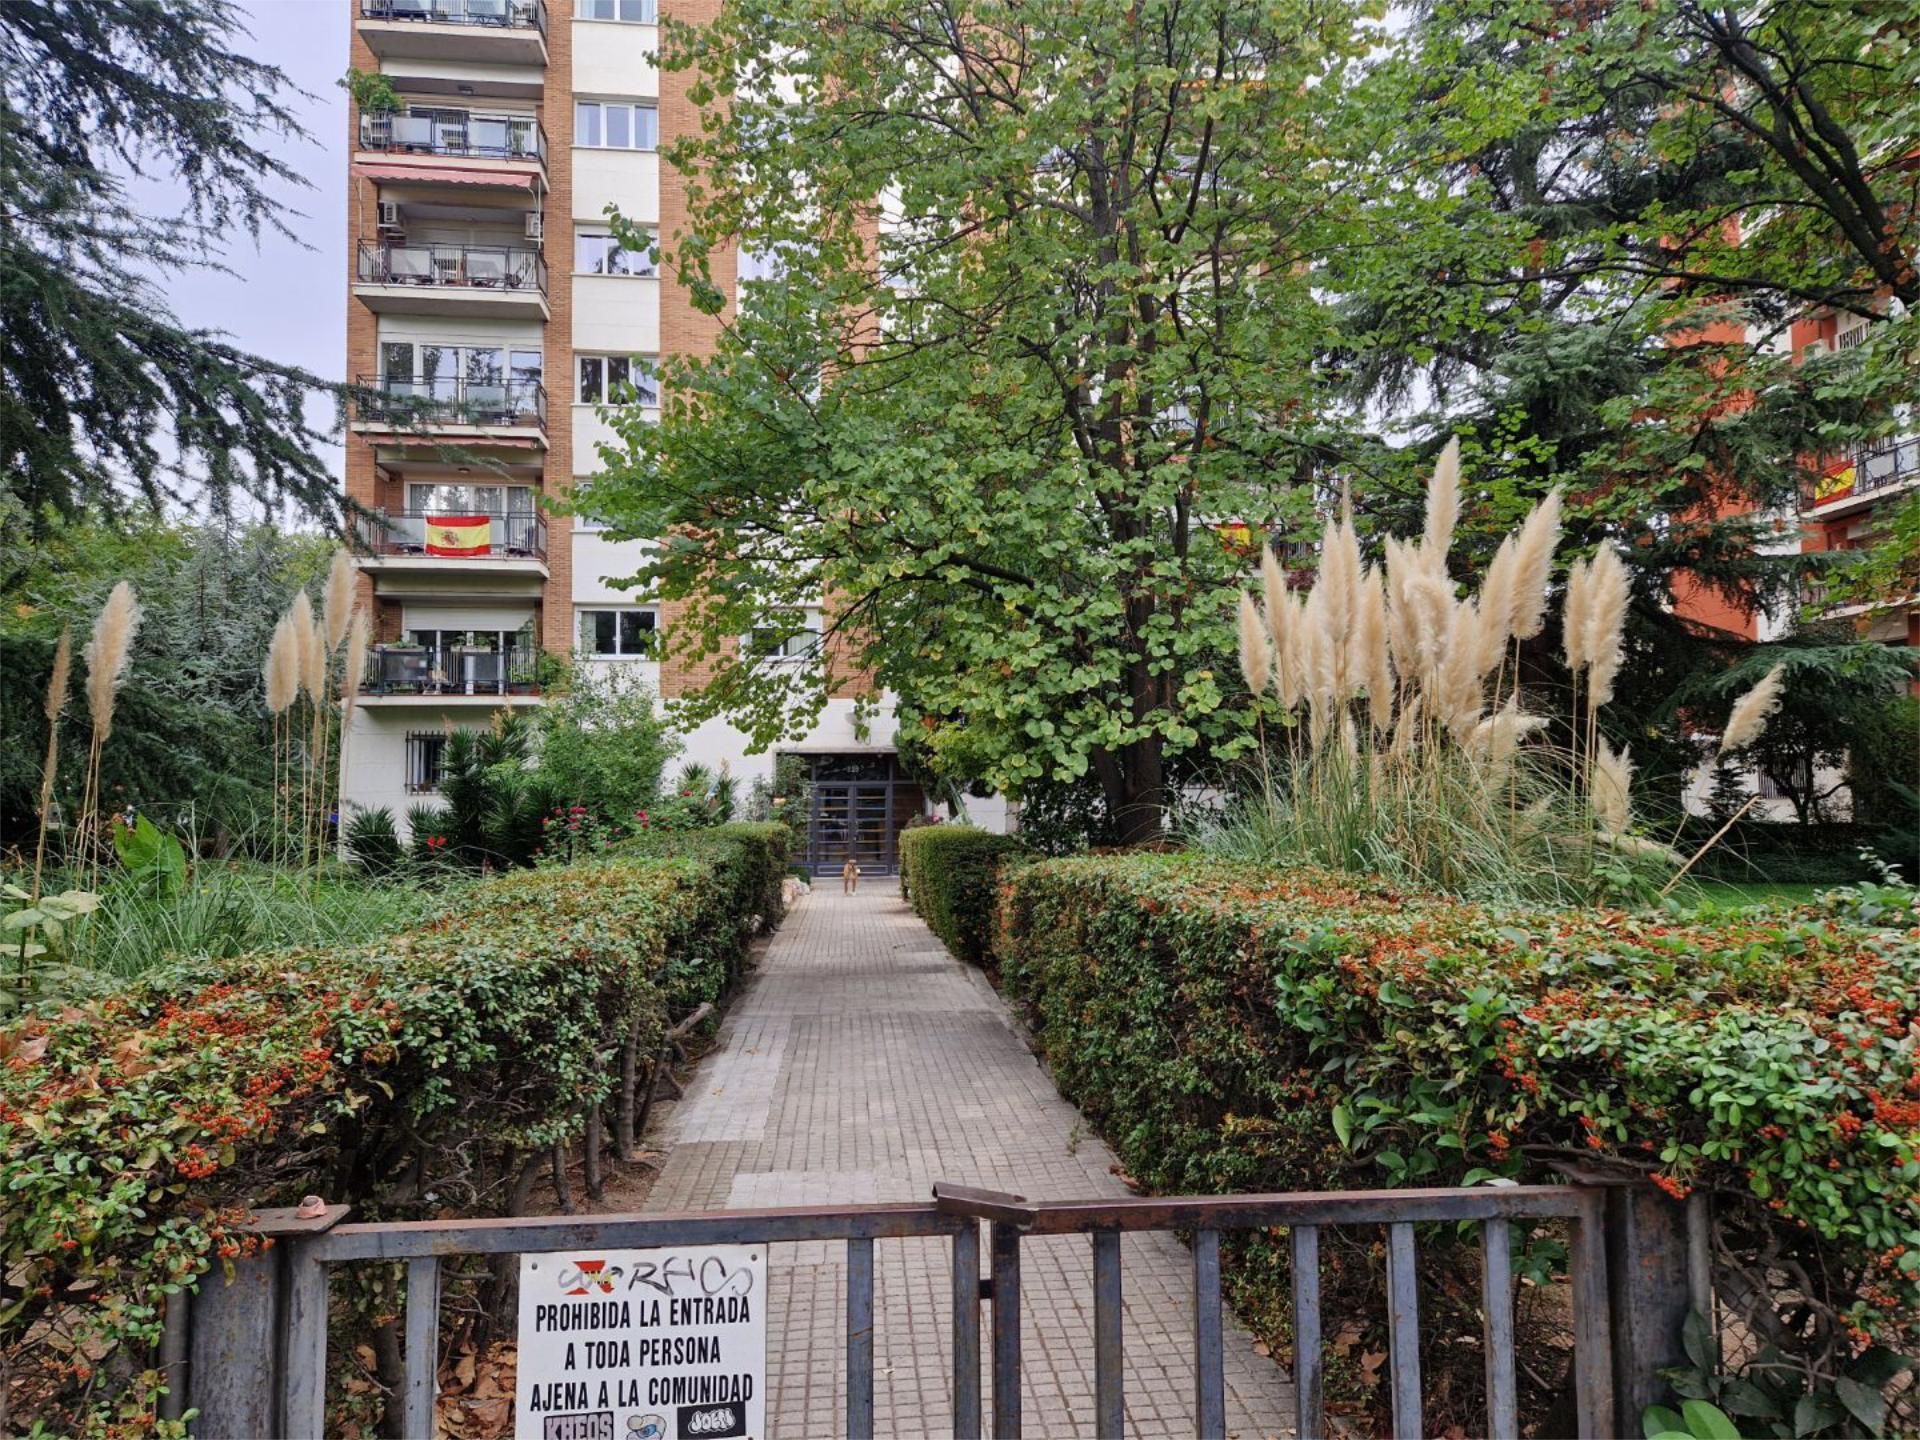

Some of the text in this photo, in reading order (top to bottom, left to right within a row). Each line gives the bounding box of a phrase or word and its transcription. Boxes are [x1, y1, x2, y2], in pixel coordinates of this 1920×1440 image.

[536, 1296, 750, 1332] PROHIBIDA LA ENTRADA
[565, 1336, 721, 1370] A TODA PERSONA
[530, 1374, 752, 1412] AJENA A LA COMUNIDAD
